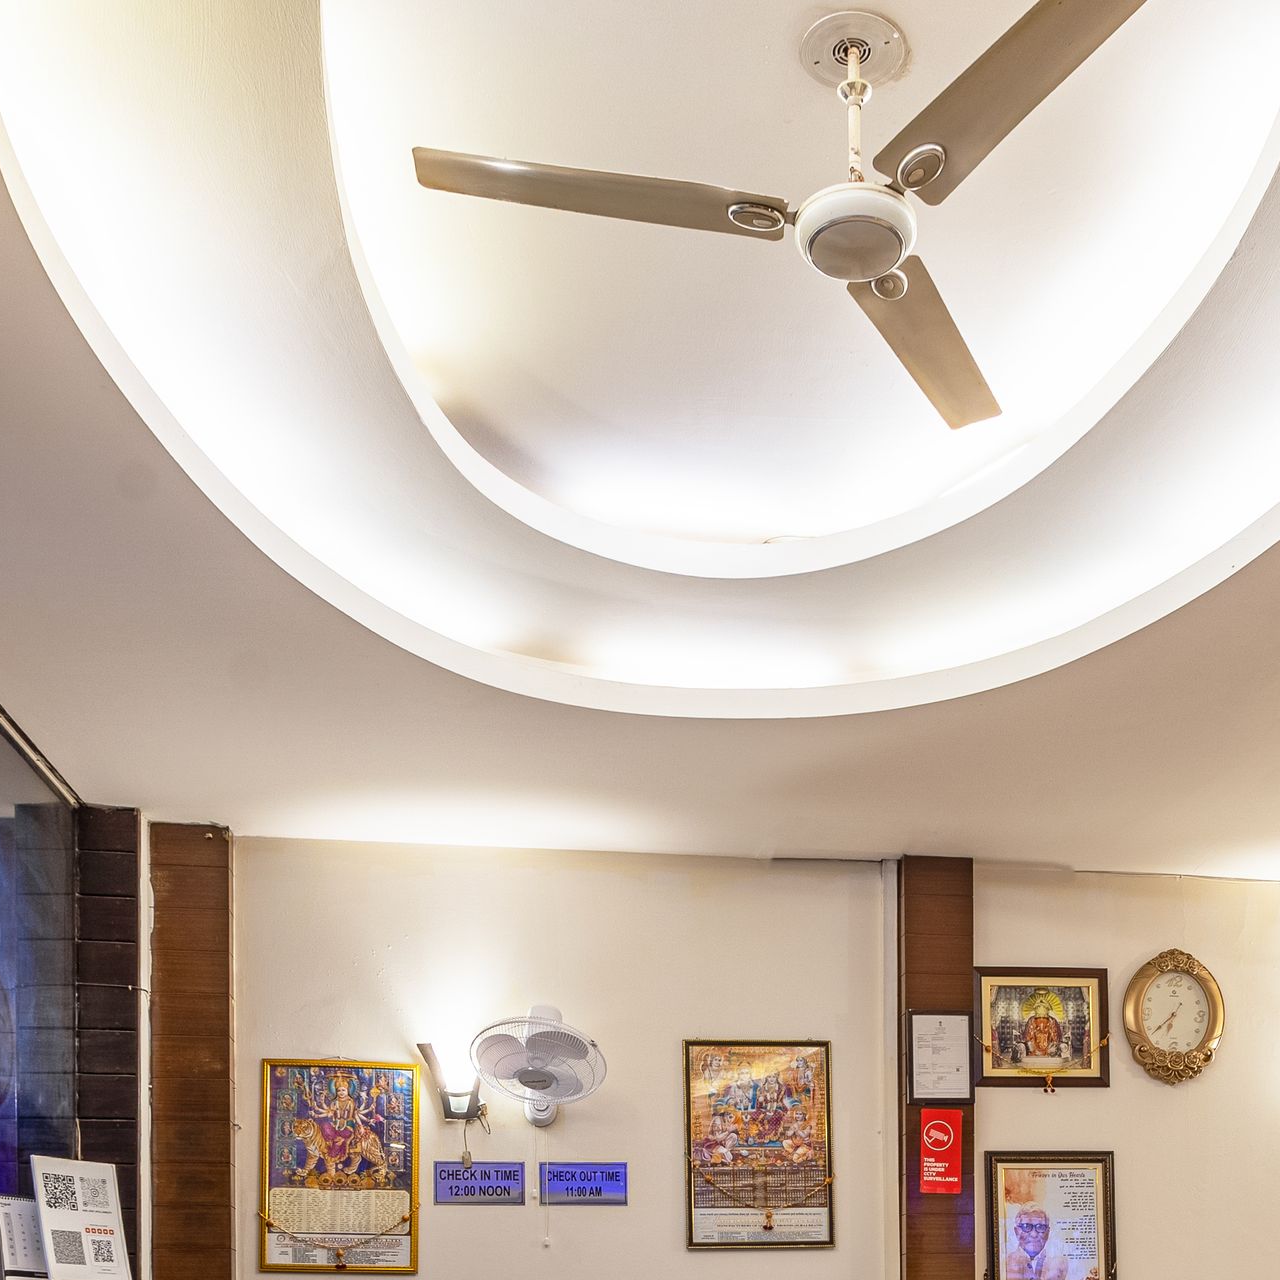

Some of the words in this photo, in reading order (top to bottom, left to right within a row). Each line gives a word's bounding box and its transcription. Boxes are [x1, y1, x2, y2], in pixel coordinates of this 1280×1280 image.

[439, 1169, 477, 1181] CHECK
[480, 1170, 491, 1181] IN
[495, 1169, 520, 1182] TIME
[547, 1170, 577, 1182] CHECK
[579, 1170, 597, 1182] OUT
[599, 1170, 621, 1182] TIME
[448, 1185, 476, 1197] 12:00
[478, 1185, 511, 1197] NOON
[565, 1186, 587, 1197] 11:00
[588, 1186, 603, 1197] AM
